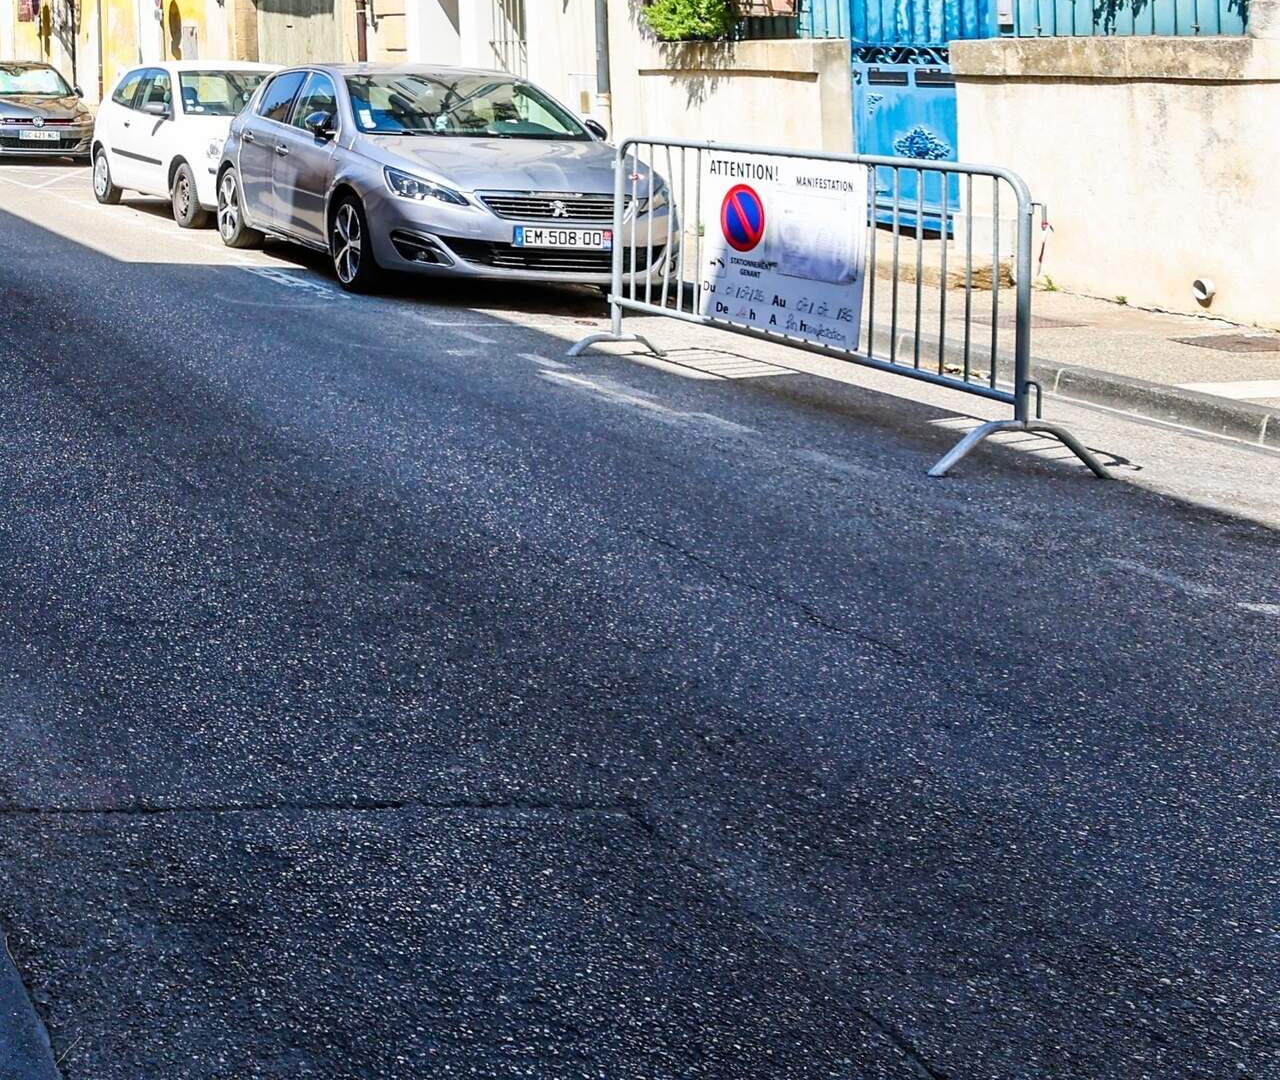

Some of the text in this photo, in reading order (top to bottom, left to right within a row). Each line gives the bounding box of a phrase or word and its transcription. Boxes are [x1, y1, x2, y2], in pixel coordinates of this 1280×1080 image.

[796, 176, 854, 192] MANIFESTATION
[703, 281, 716, 293] Du
[771, 295, 787, 308] Au
[716, 302, 729, 314] De
[749, 308, 756, 320] h
[769, 314, 777, 325] A
